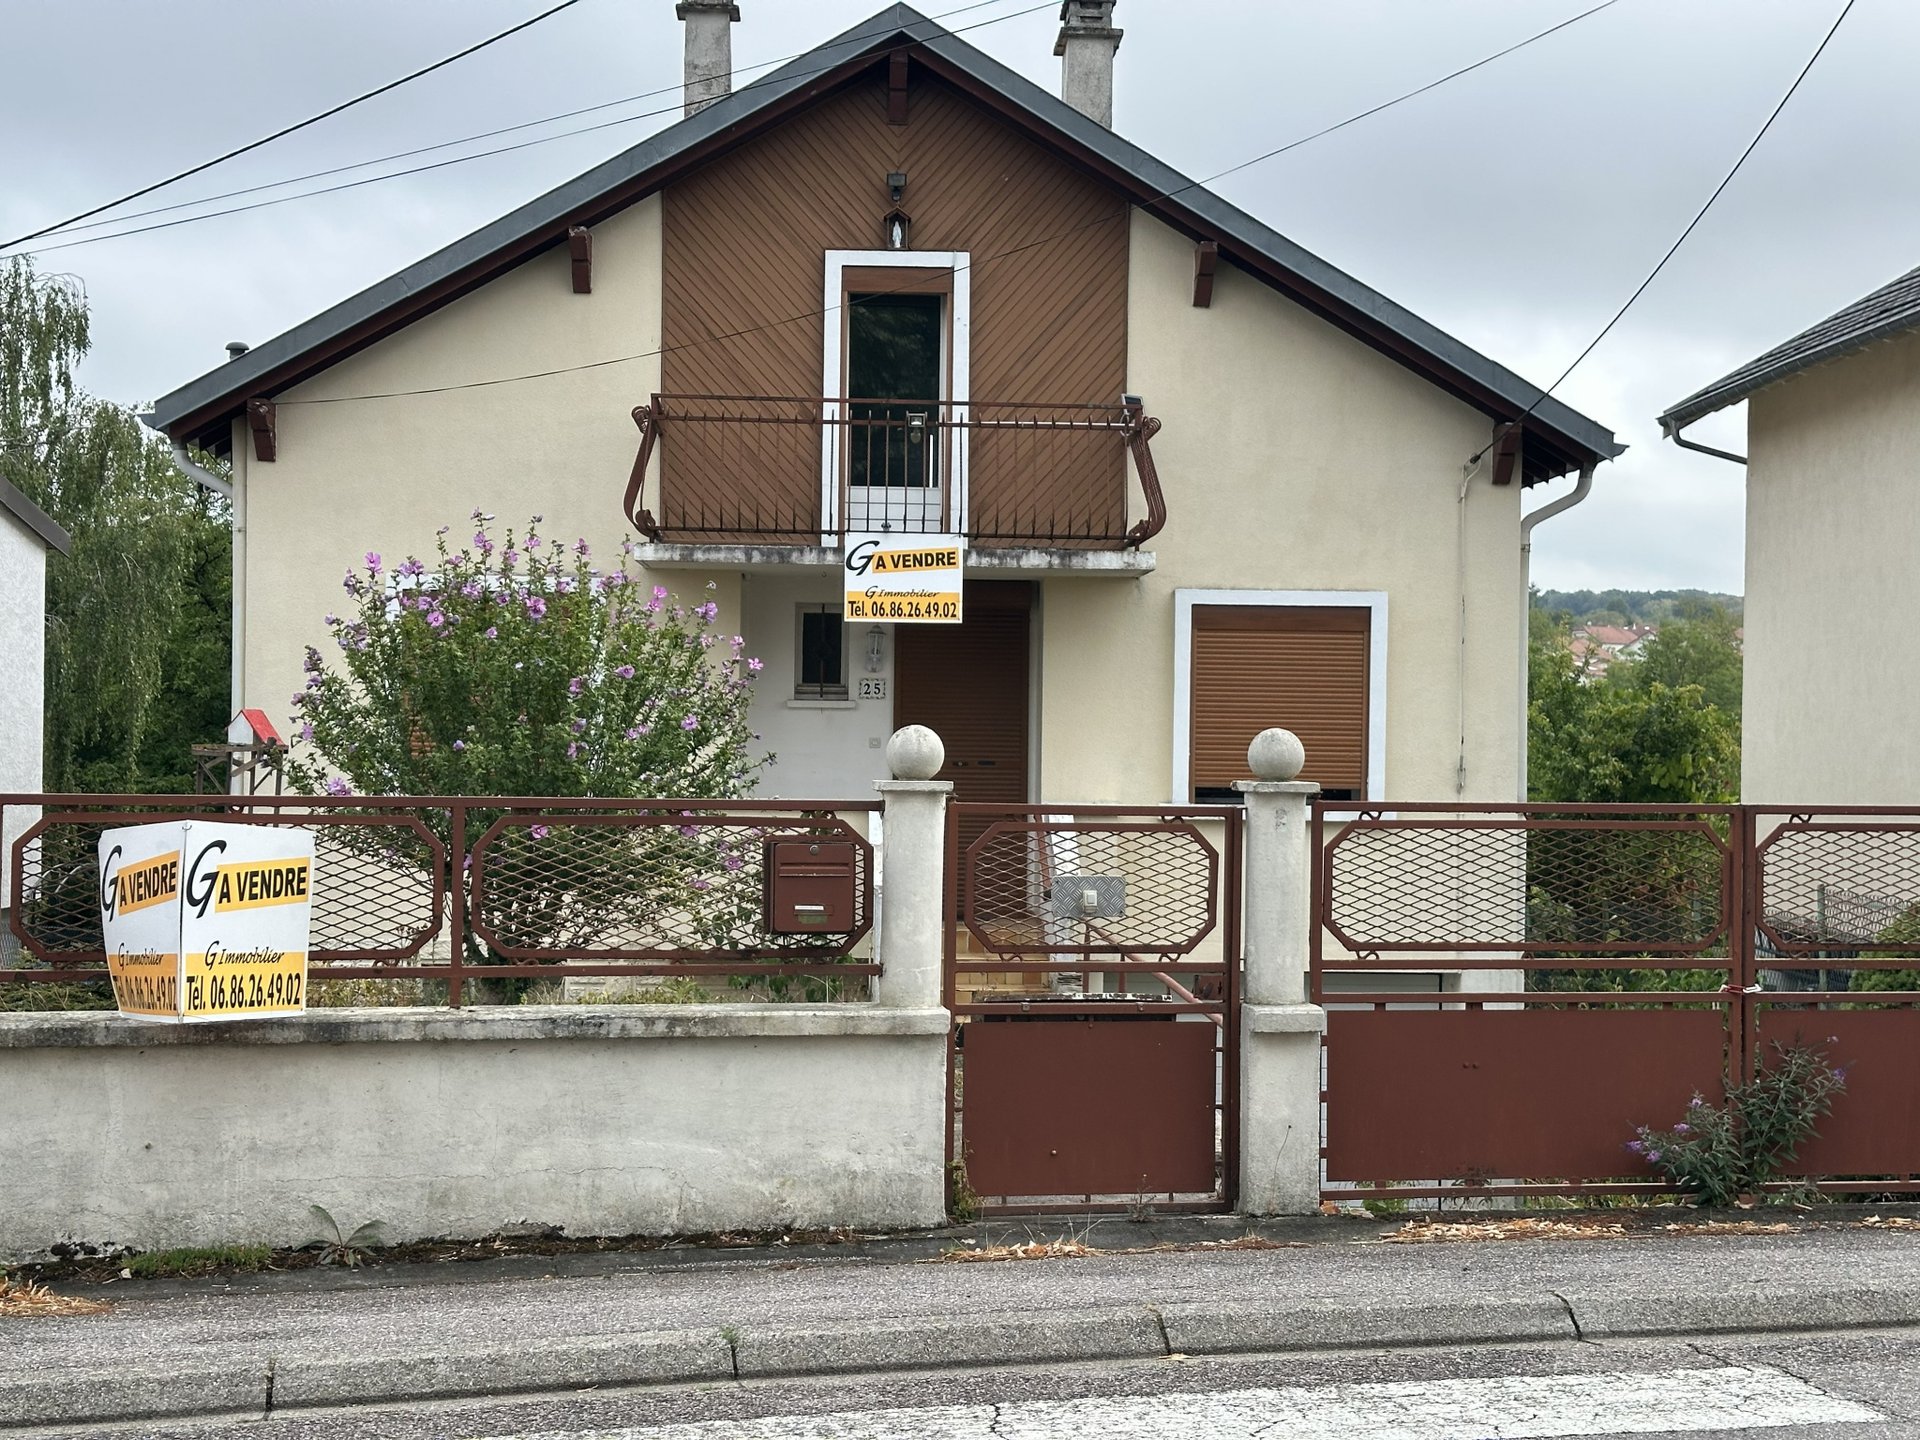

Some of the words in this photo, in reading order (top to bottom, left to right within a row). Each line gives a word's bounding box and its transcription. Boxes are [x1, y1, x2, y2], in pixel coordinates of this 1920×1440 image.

[846, 541, 880, 576] G
[875, 555, 887, 570] A
[890, 551, 957, 569] VENDRE
[848, 600, 868, 618] Tél.
[871, 602, 957, 618] 06.86.26.49.02
[863, 683, 881, 695] 25
[102, 845, 122, 922] G
[119, 874, 128, 907] A
[130, 861, 177, 902] VENDRE
[186, 840, 227, 919] G
[218, 873, 231, 904] A
[237, 866, 308, 902] VENDRE
[218, 946, 285, 967] Immobilier
[186, 975, 206, 1011] Tél.
[210, 973, 301, 1010] 06.86.26.49.02
